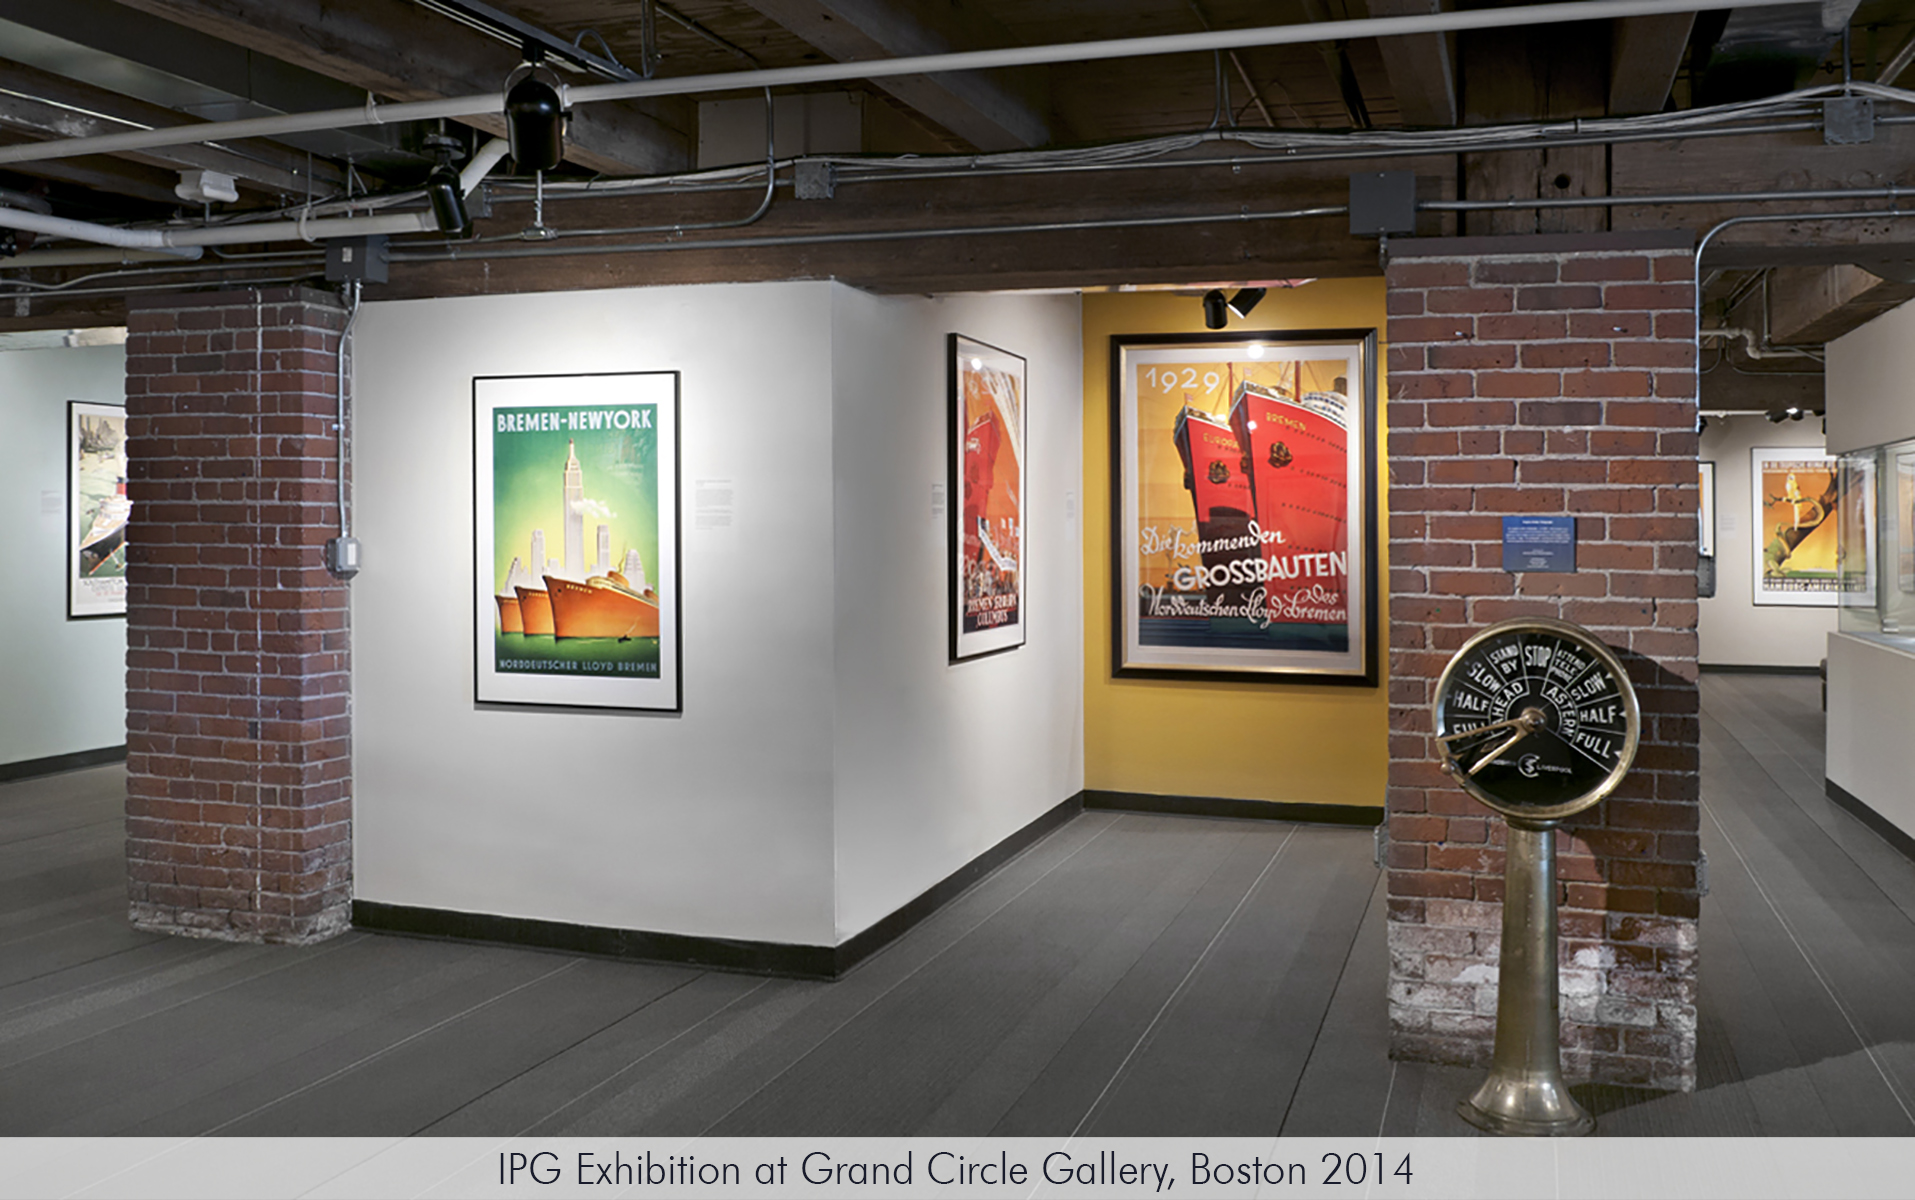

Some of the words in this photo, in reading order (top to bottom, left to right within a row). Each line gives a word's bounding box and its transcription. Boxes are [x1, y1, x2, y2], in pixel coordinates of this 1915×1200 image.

[1145, 367, 1220, 394] 1929
[497, 410, 652, 432] BREMEN-NEWYORK
[1266, 412, 1306, 431] BREMEN
[1141, 525, 1172, 555] Die
[1173, 520, 1286, 559] kommenden
[1174, 551, 1347, 591] GROSSBAUTEN
[499, 658, 578, 671] NORDDEUTSCHER
[582, 660, 614, 672] LLOYD
[617, 662, 658, 673] BREMEN
[1489, 644, 1519, 664] STAND
[1524, 645, 1552, 668] STOP
[1466, 661, 1502, 693] SLOW
[1501, 659, 1518, 674] BY
[1570, 671, 1607, 701] SLOW
[1452, 690, 1490, 712] HALF
[1546, 686, 1576, 738] ASTERN
[1580, 705, 1617, 724] HALF
[1575, 732, 1612, 759] FULL
